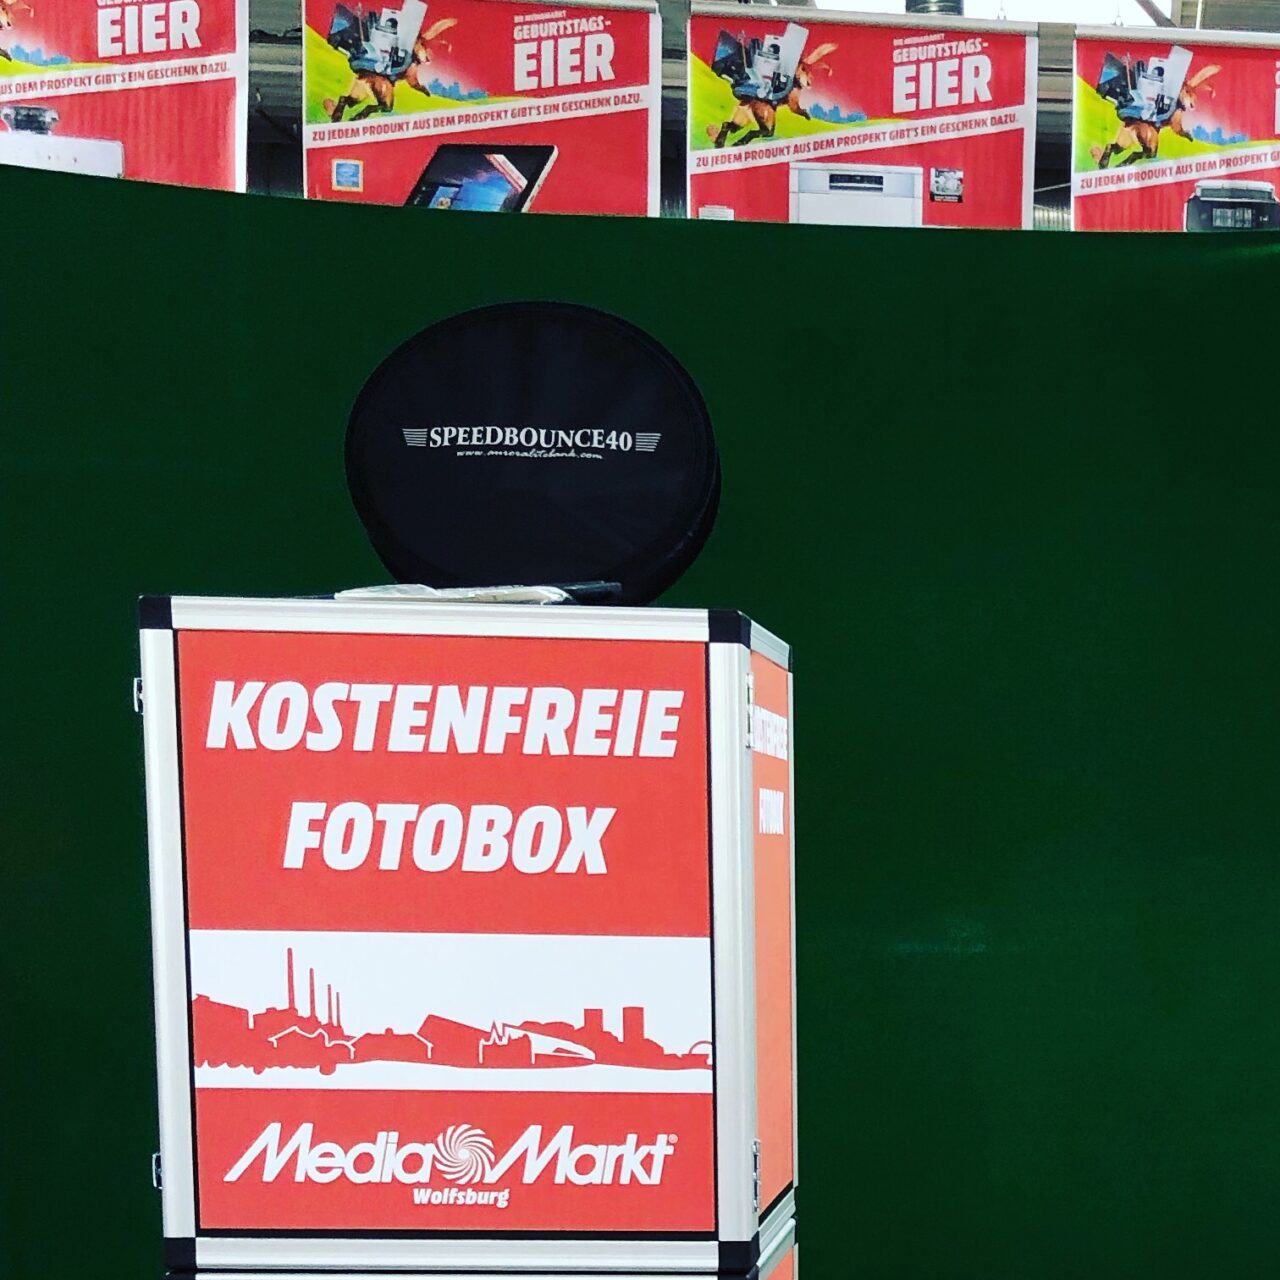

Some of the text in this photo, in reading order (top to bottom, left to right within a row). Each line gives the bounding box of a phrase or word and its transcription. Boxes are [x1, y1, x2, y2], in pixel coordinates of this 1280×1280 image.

[97, 0, 201, 58] EIER
[514, 16, 611, 40] GEBURTSTAGS-
[893, 38, 989, 63] GEBURTSTAGS-
[16, 81, 37, 93] DEM
[40, 75, 92, 90] PROSPEKT
[95, 71, 125, 85] GIBT'S
[128, 70, 145, 82] EIN
[147, 65, 199, 80] GESCHENK
[513, 33, 615, 91] EIER
[892, 55, 993, 114] EIER
[312, 130, 325, 141] ZU
[327, 126, 360, 141] JEDEM
[362, 121, 410, 138] PRODUKT
[412, 118, 431, 131] AUS
[433, 116, 456, 128] DEM
[457, 109, 508, 126] PROSPEKT
[511, 104, 542, 119] GIBT'S
[543, 102, 560, 115] EIN
[561, 96, 611, 113] GESCHENK
[696, 155, 709, 168] ZU
[711, 151, 743, 167] JEDEM
[744, 145, 791, 163] PRODUKT
[793, 142, 811, 155] AUS
[813, 138, 835, 152] DEM
[836, 131, 887, 149] PROSPEKT
[889, 126, 919, 141] GIBT'S
[920, 124, 938, 137] EIN
[938, 118, 989, 135] GESCHENK
[430, 426, 632, 451] SPEEDBOUNCE40
[205, 680, 684, 758] KOSTENFREIE
[282, 801, 617, 874] FOTOBOX
[224, 1123, 676, 1185] Media Markt
[412, 1187, 510, 1209] Wolfsburg
